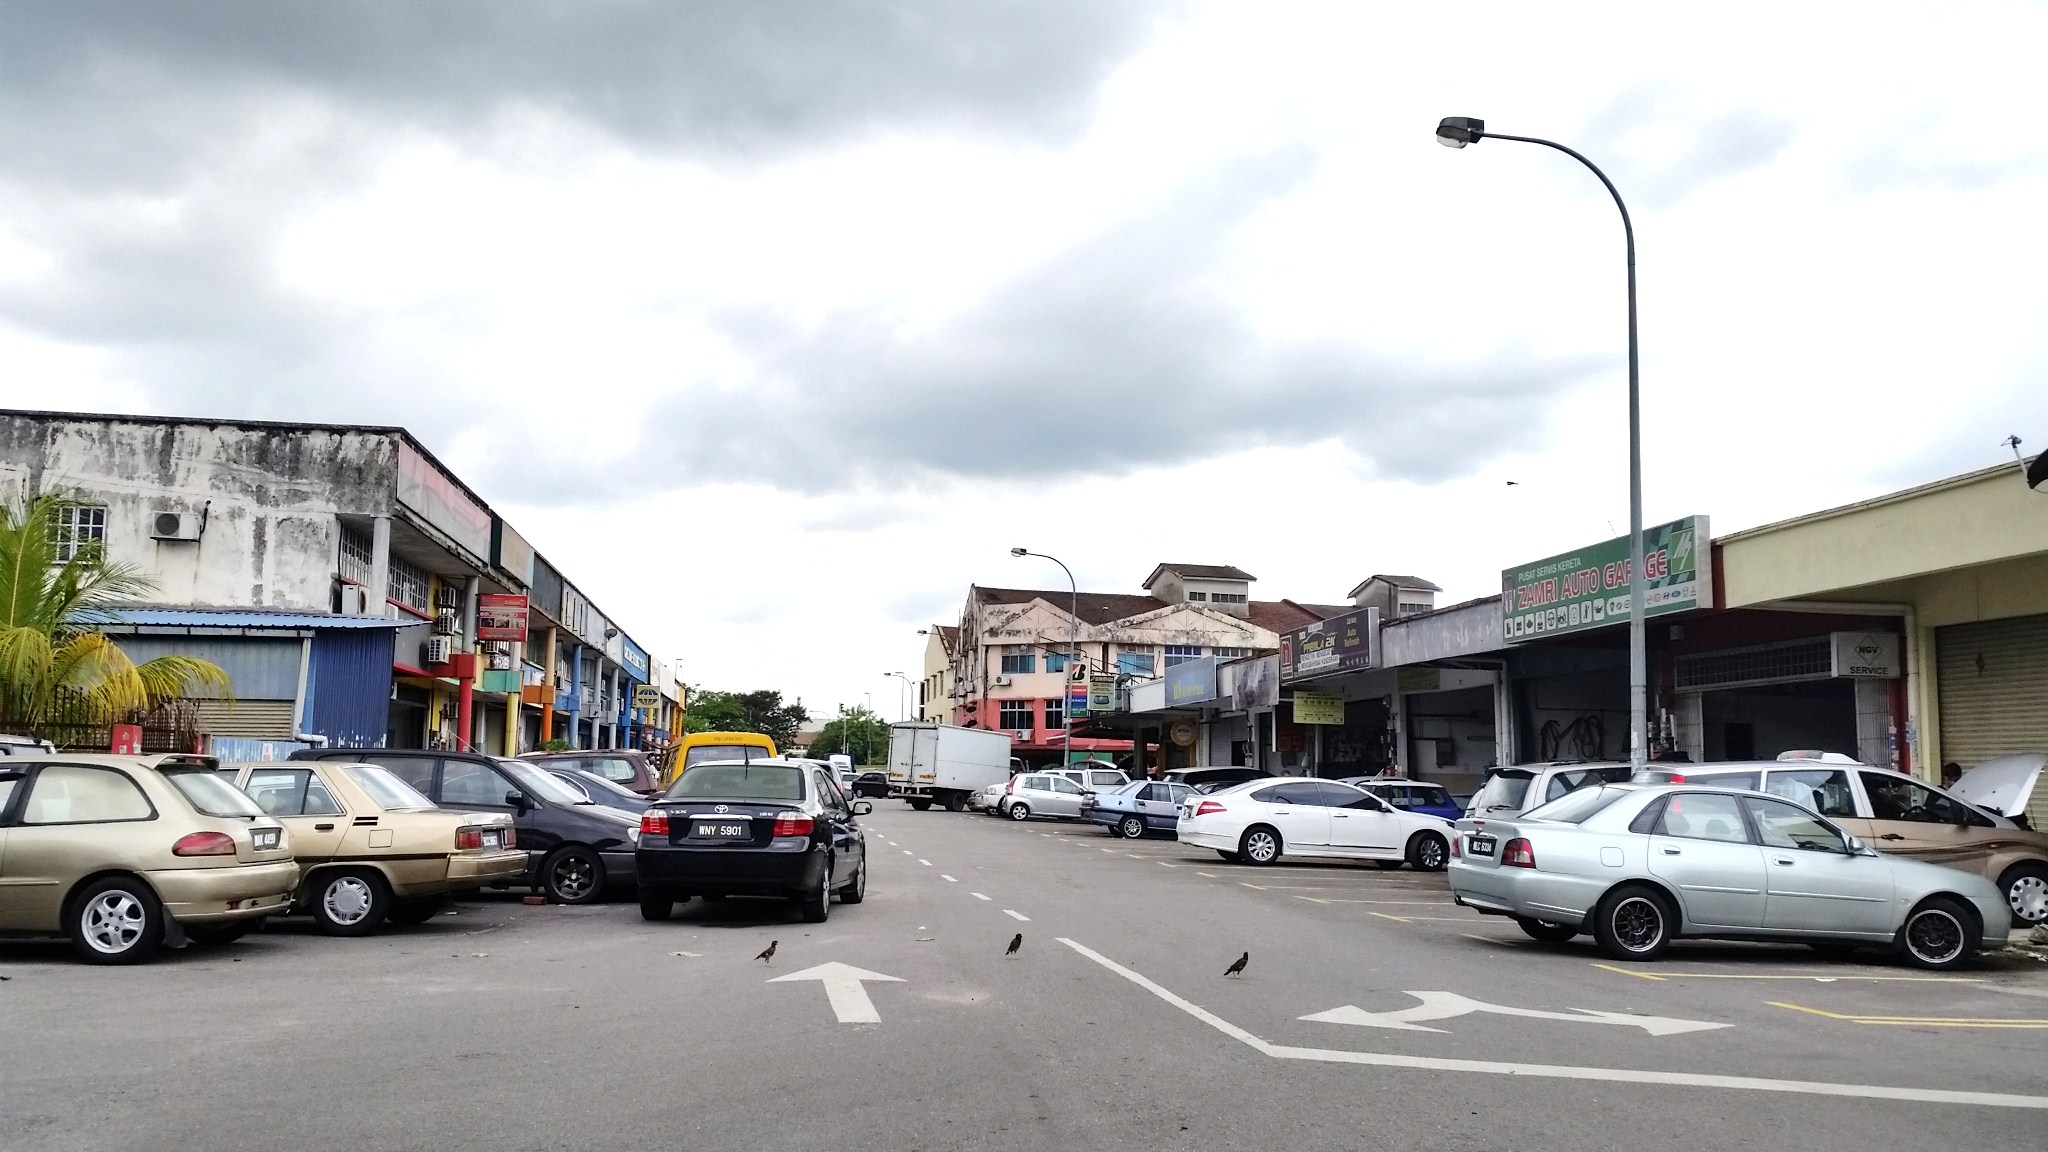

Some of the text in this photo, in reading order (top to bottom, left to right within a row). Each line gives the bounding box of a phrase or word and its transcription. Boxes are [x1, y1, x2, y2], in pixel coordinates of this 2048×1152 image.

[1518, 557, 1581, 583] PUSAT SERVIS KERETA
[1518, 549, 1668, 611] ZAMRI AUTO GARGE
[1858, 646, 1878, 654] NGV
[1850, 665, 1888, 675] SERVICE
[699, 825, 742, 836] WNY 5901
